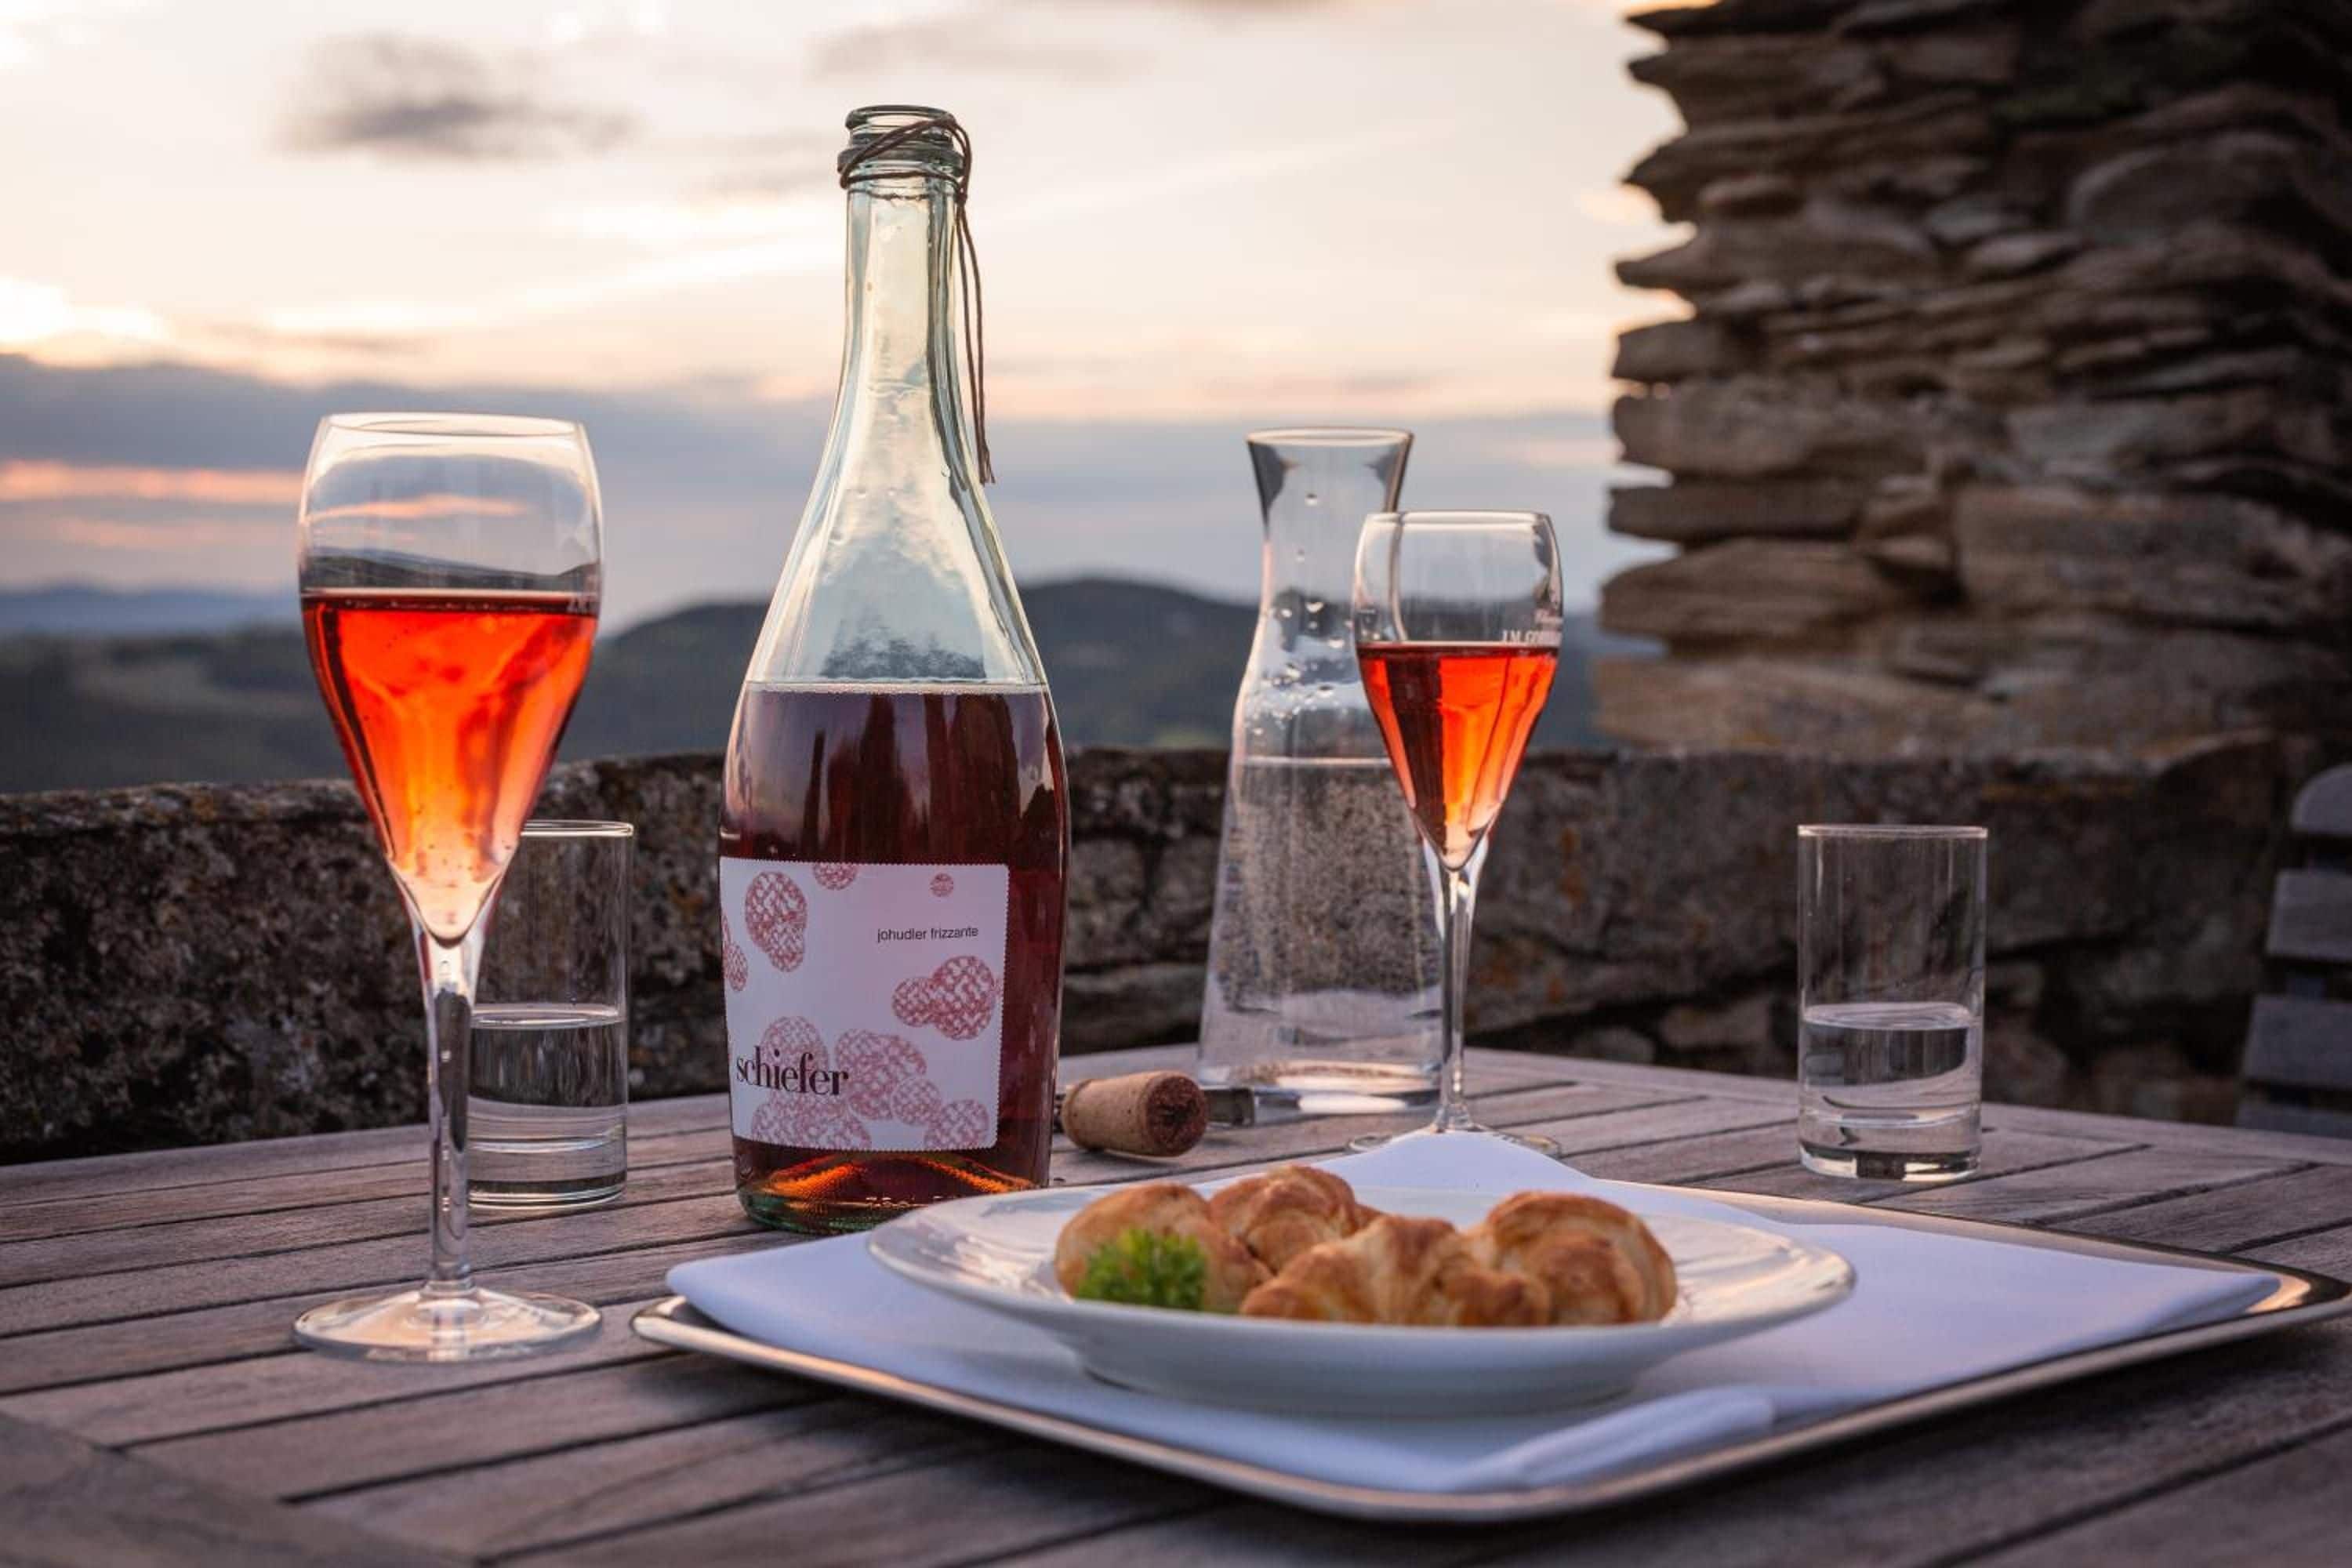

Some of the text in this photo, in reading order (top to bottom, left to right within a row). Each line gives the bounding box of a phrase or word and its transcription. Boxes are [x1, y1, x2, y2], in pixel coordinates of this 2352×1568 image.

[877, 927, 979, 943] johudler frizzante
[736, 1046, 849, 1095] schiefer
